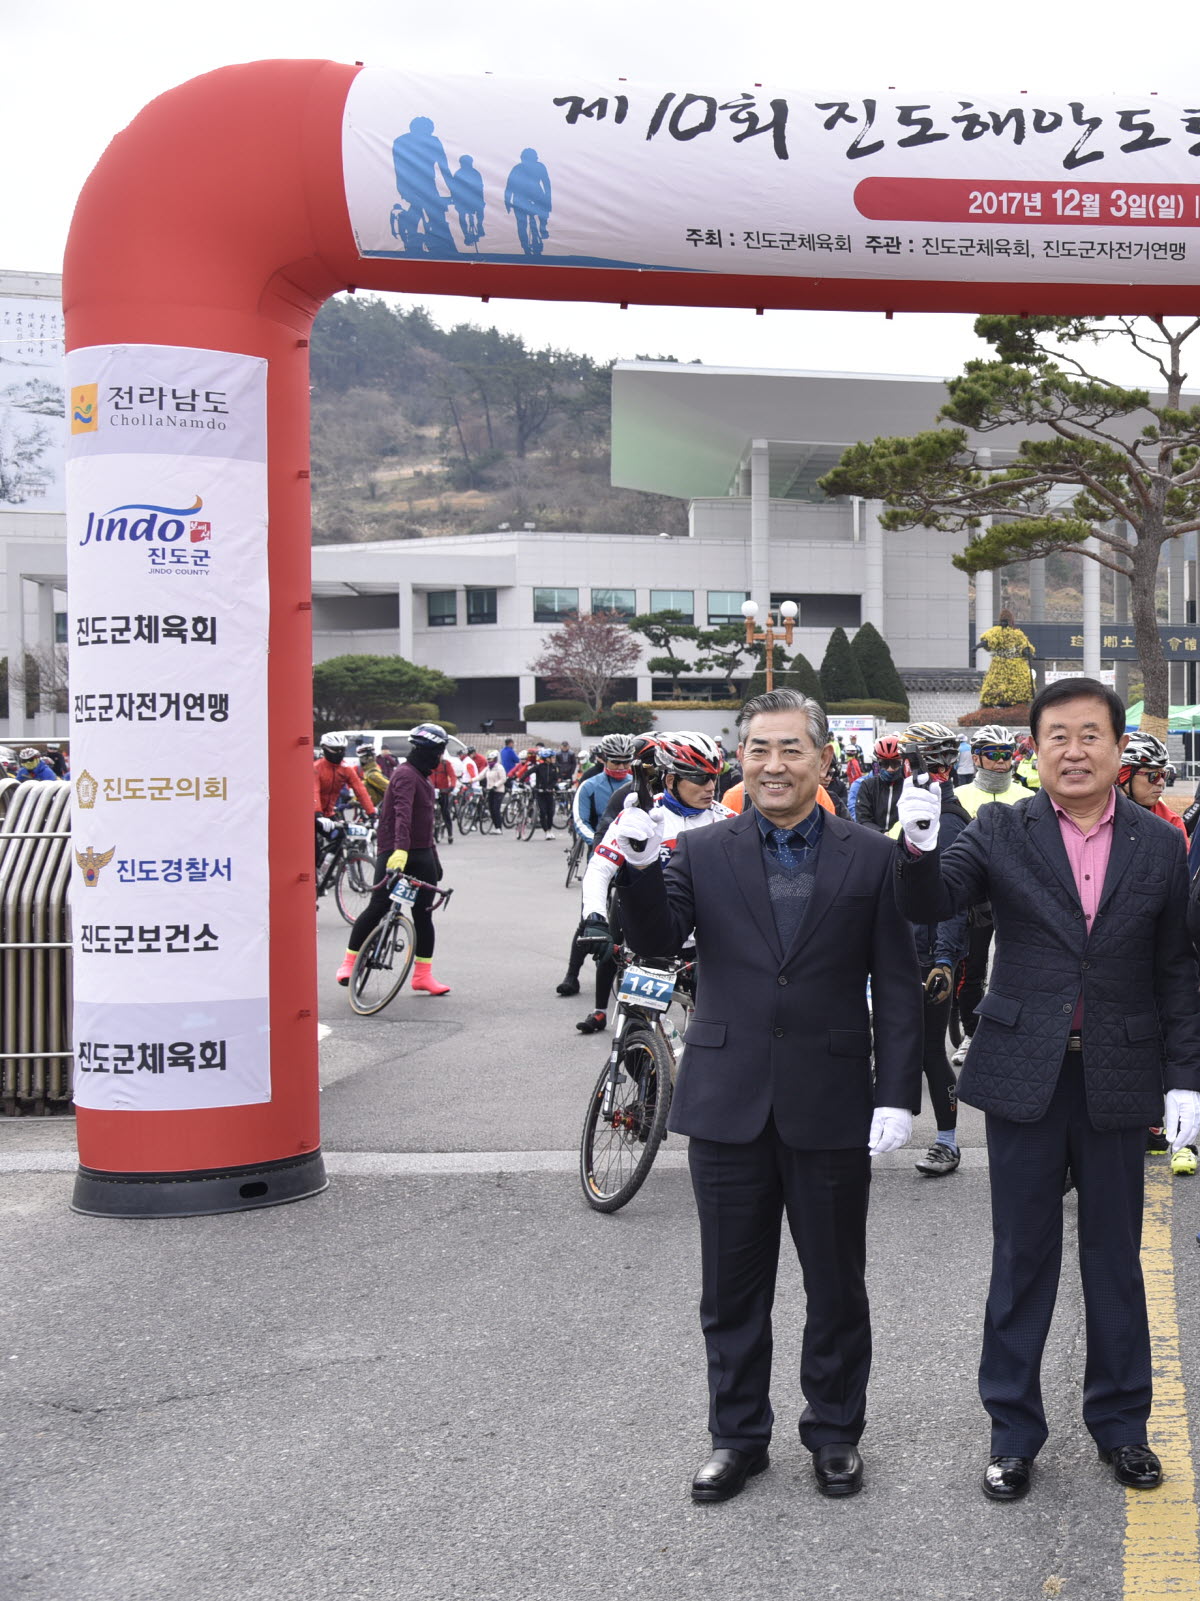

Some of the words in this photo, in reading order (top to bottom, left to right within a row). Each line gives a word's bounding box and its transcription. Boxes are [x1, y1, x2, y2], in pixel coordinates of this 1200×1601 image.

[968, 190, 1043, 217] 2017년
[1052, 188, 1101, 218] 12월
[1110, 189, 1184, 219] 3일(일)
[743, 230, 852, 253] 진도군체육회
[921, 236, 1035, 259] 진도군체육회,
[1042, 239, 1187, 261] 진도군자전거연맹
[107, 385, 229, 415] 전라남도
[110, 413, 227, 432] ChollaNamdo
[80, 511, 185, 547] Jindo
[147, 548, 212, 567] 진도군
[148, 567, 173, 575] JINDO
[175, 567, 210, 576] COUNTY
[76, 615, 217, 646] 진도군체육회
[74, 692, 230, 723] 진도군자전거연맹
[102, 776, 228, 802] 진도군의회
[116, 857, 233, 883] 진도경찰서
[396, 885, 417, 899] 213
[80, 923, 219, 954] 진도군보건소
[630, 976, 670, 998] 147
[78, 1040, 227, 1075] 진도군체육회
